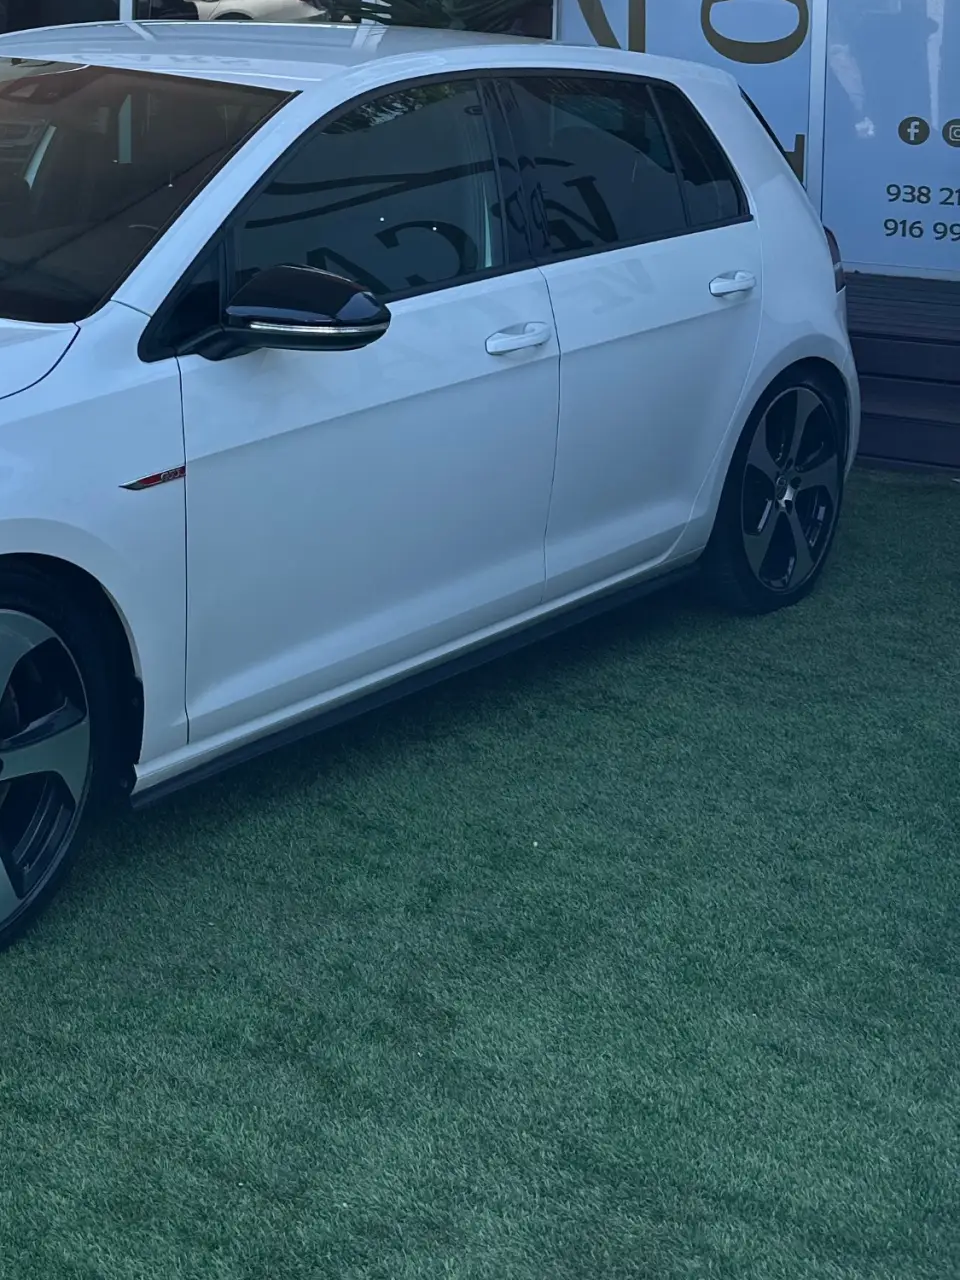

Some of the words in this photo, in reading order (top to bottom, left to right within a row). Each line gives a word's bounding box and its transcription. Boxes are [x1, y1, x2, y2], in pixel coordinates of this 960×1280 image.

[886, 184, 931, 205] 938
[883, 218, 924, 239] 916
[932, 221, 960, 242] 99
